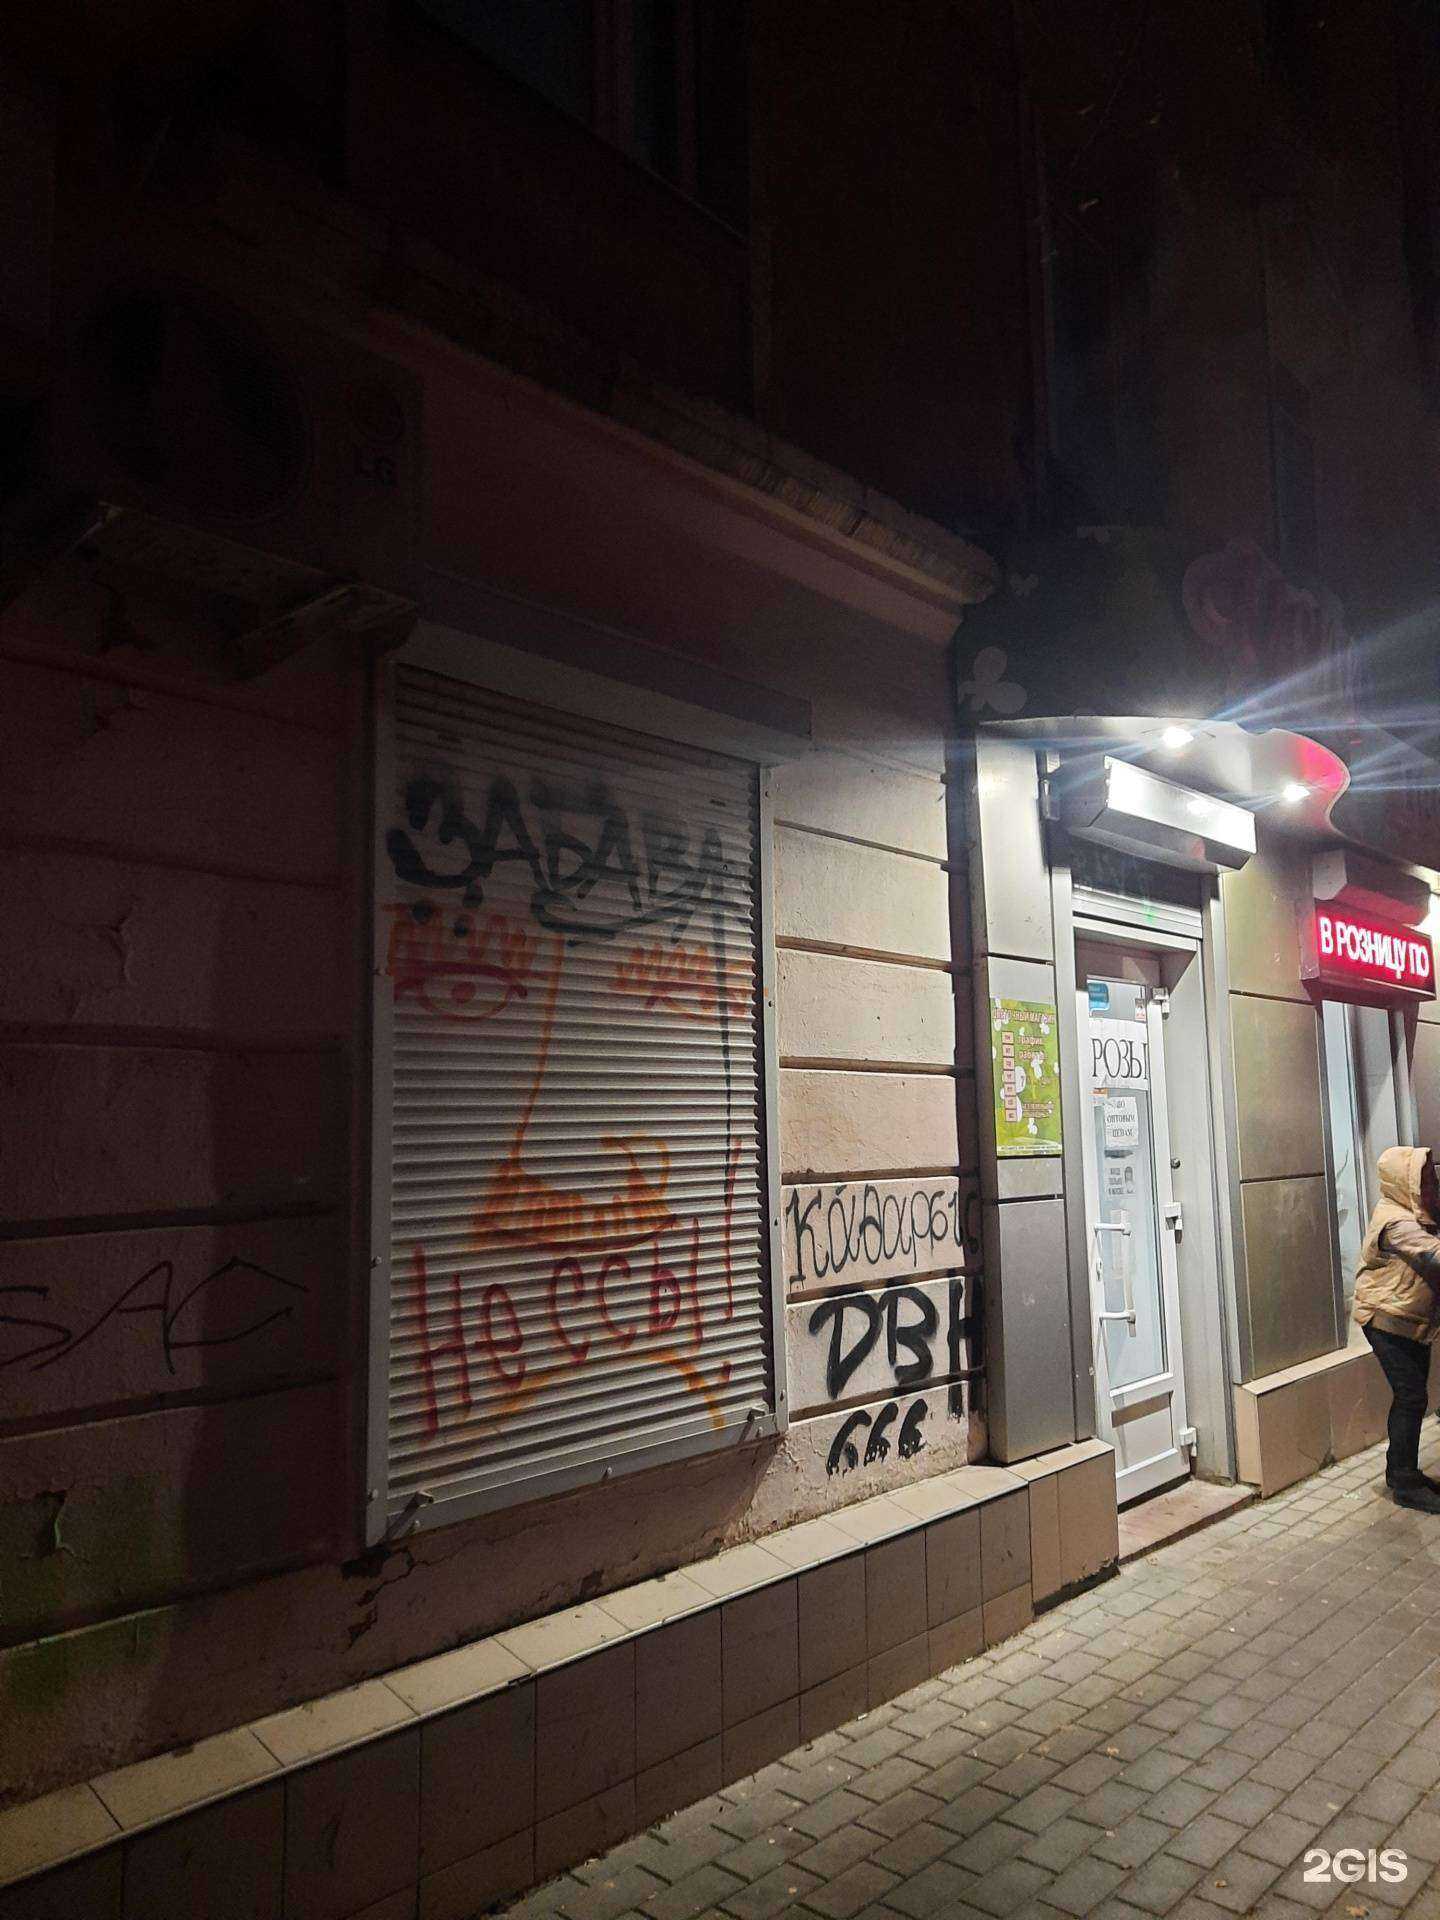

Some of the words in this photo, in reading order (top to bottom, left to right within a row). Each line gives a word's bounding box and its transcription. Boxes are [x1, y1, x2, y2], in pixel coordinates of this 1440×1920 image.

[1319, 917, 1334, 954] В
[1335, 921, 1407, 980] РОЗНИЦУ
[1408, 942, 1430, 978] ПО
[1091, 1038, 1148, 1080] РОЗЫ
